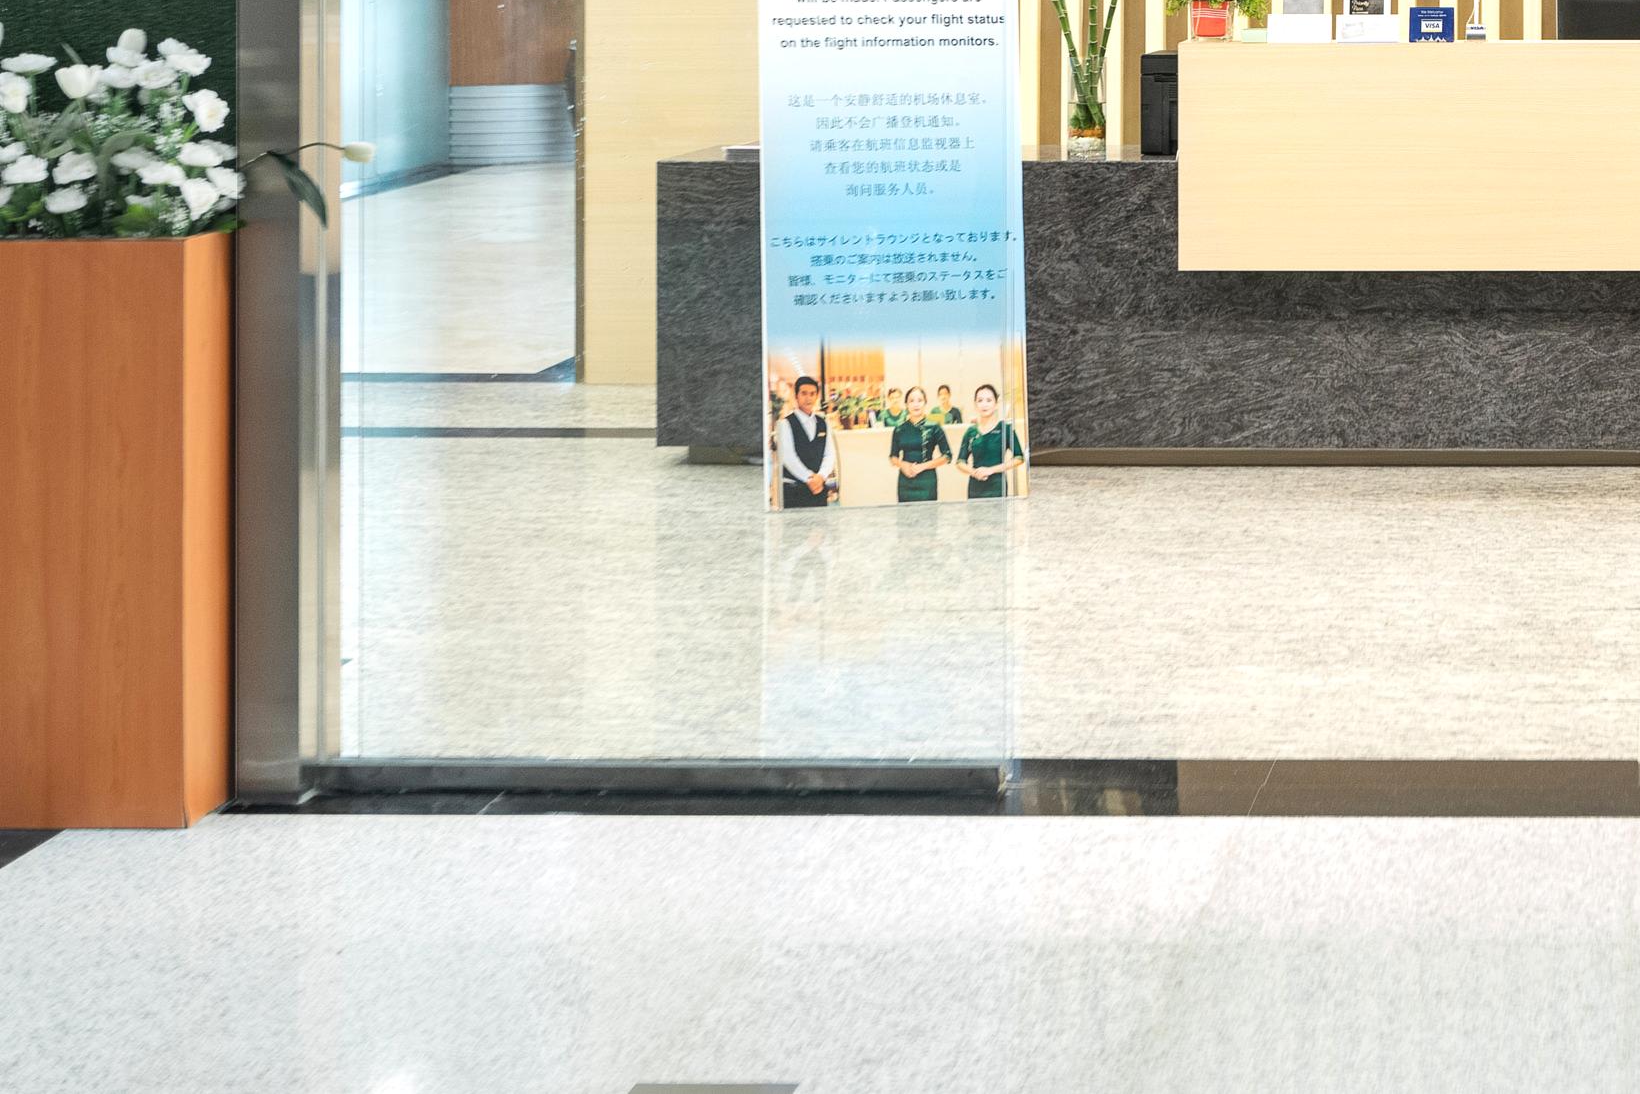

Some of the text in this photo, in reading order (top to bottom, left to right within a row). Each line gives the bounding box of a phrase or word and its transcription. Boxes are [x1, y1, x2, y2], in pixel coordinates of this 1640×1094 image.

[772, 13, 1006, 28] requested to check your flight status
[780, 35, 999, 50] on the flight information monitors.
